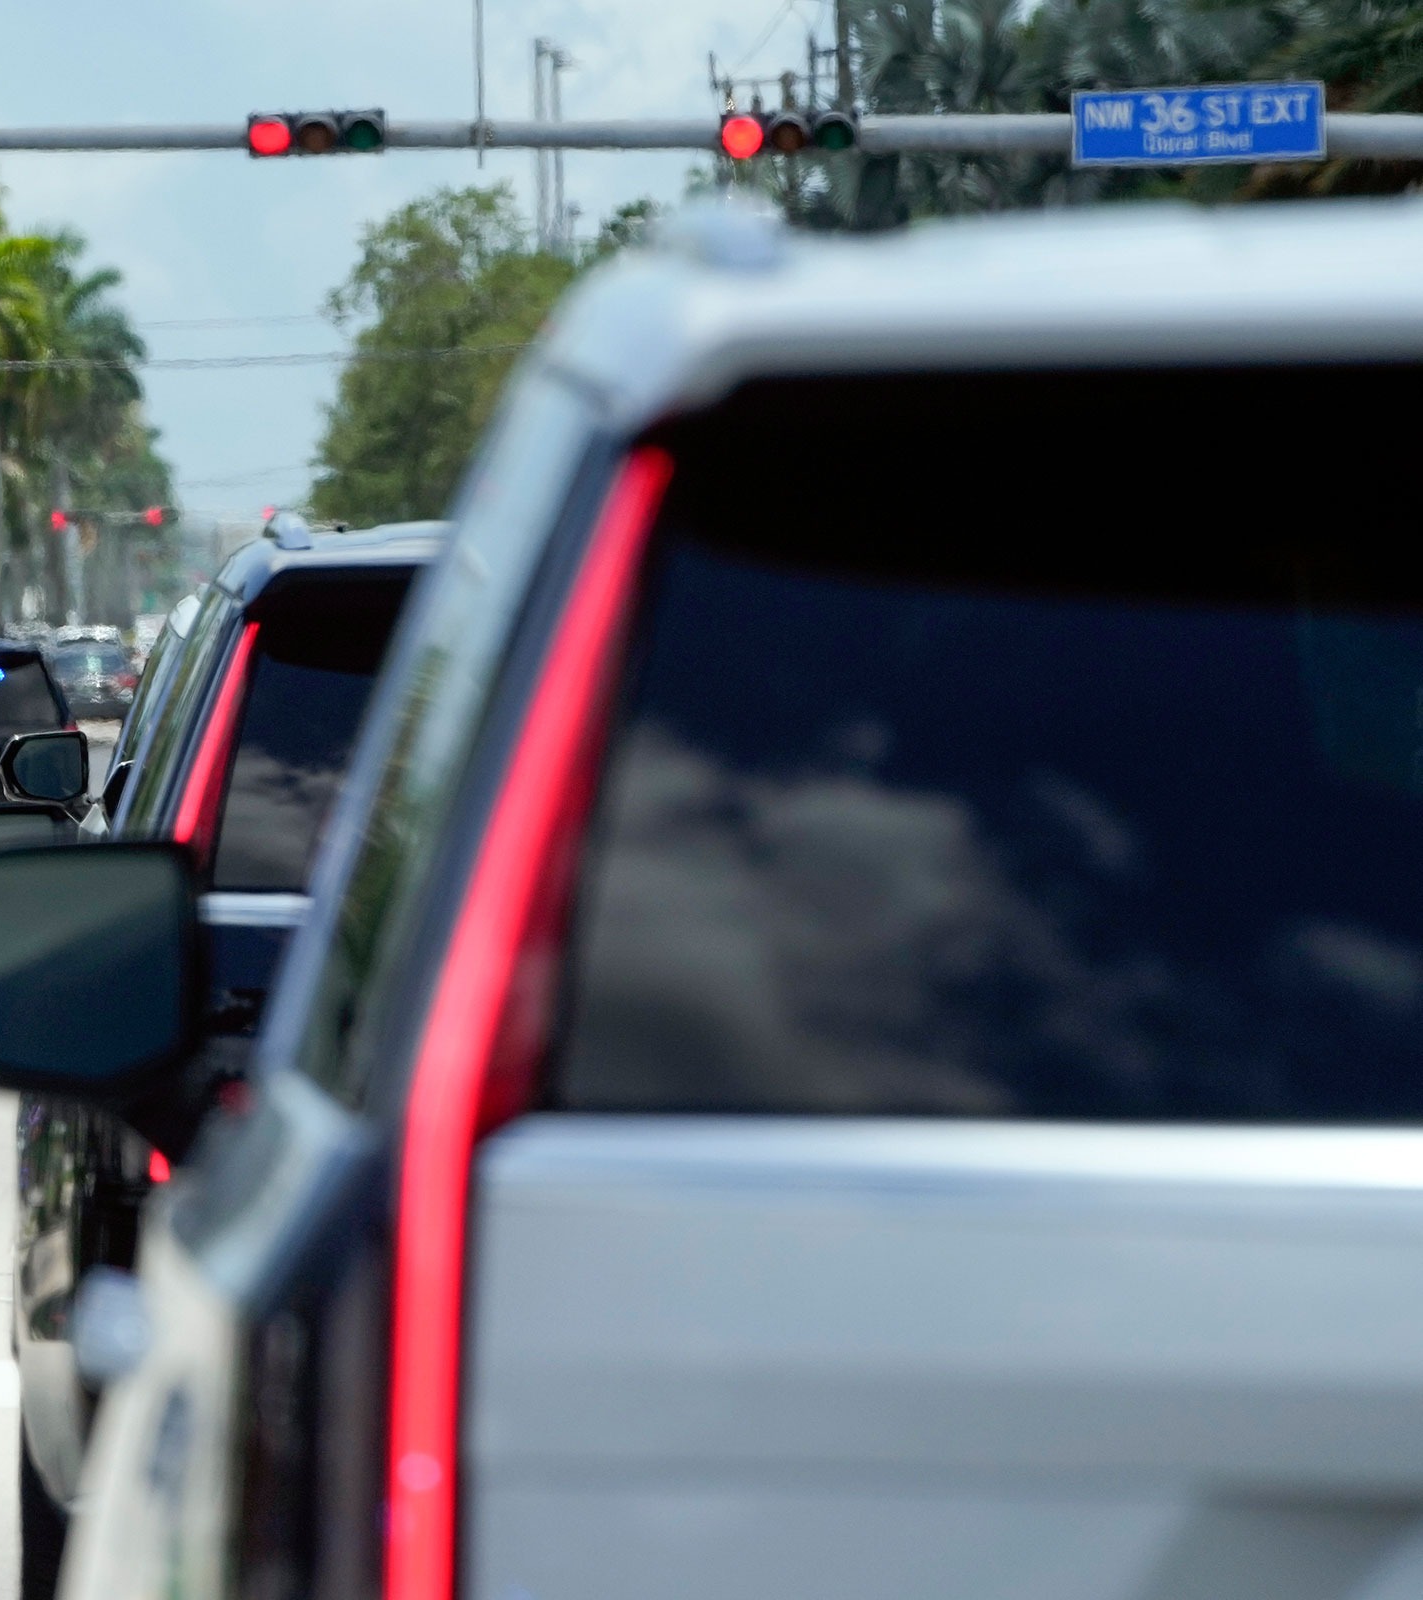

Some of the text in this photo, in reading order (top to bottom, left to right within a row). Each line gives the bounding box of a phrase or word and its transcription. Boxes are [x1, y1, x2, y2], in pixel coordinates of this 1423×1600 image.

[1085, 93, 1312, 132] NW 36 ST EXT
[1209, 131, 1252, 149] Blvd
